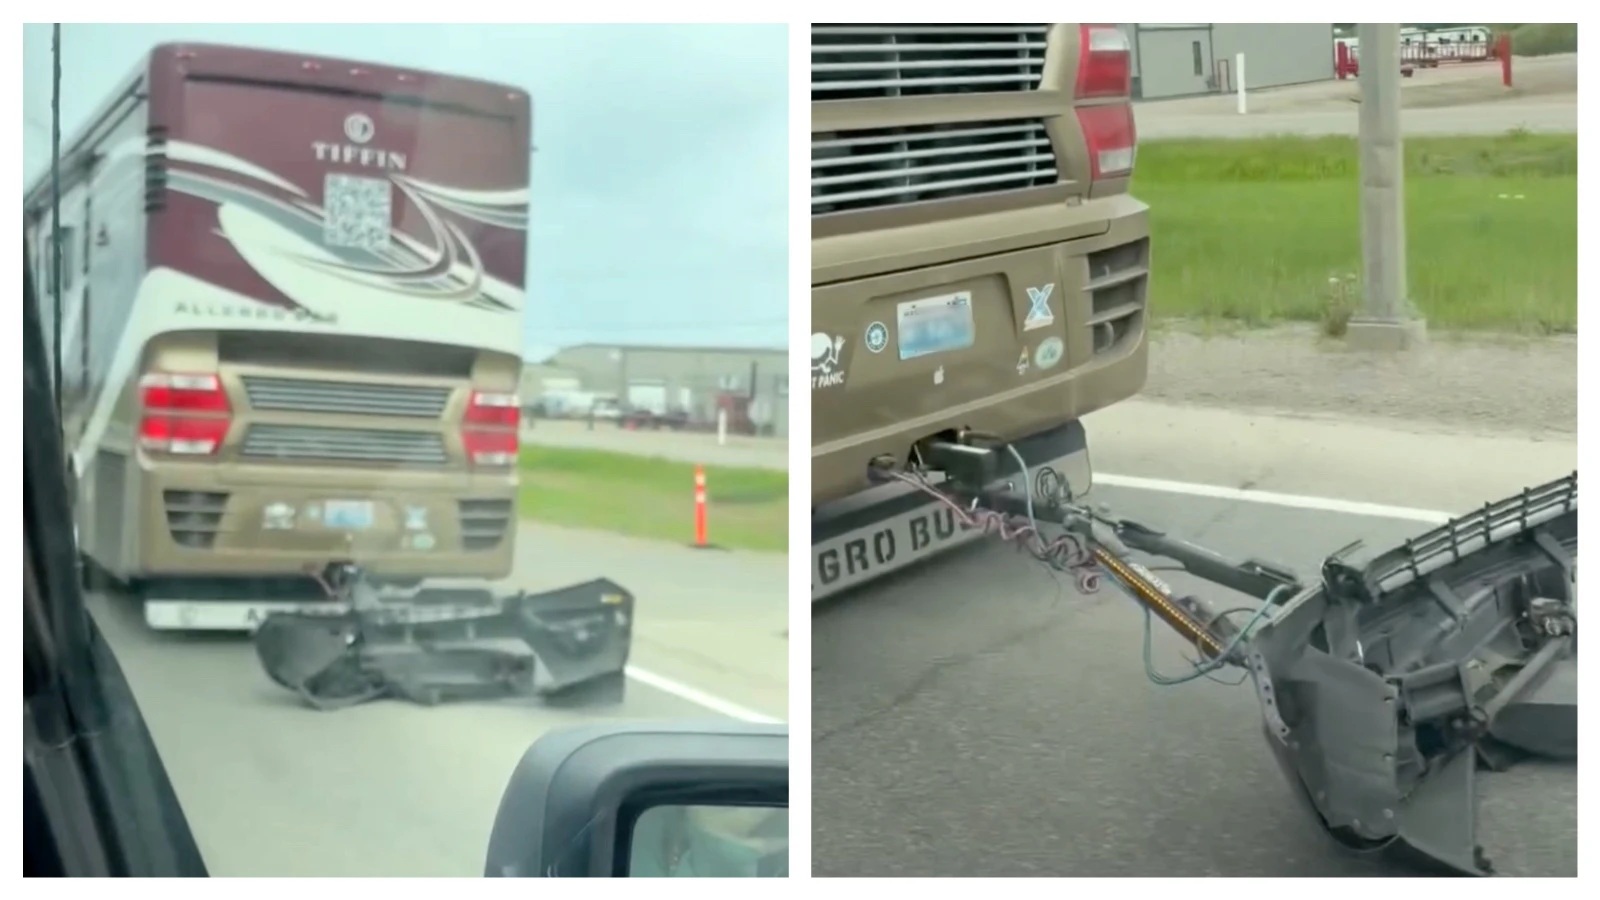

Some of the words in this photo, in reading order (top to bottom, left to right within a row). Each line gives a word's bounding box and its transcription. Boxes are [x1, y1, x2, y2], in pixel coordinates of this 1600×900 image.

[311, 141, 407, 170] TIFFIN
[818, 370, 845, 388] PANIC
[811, 528, 896, 591] GRO
[909, 505, 972, 551] BU
